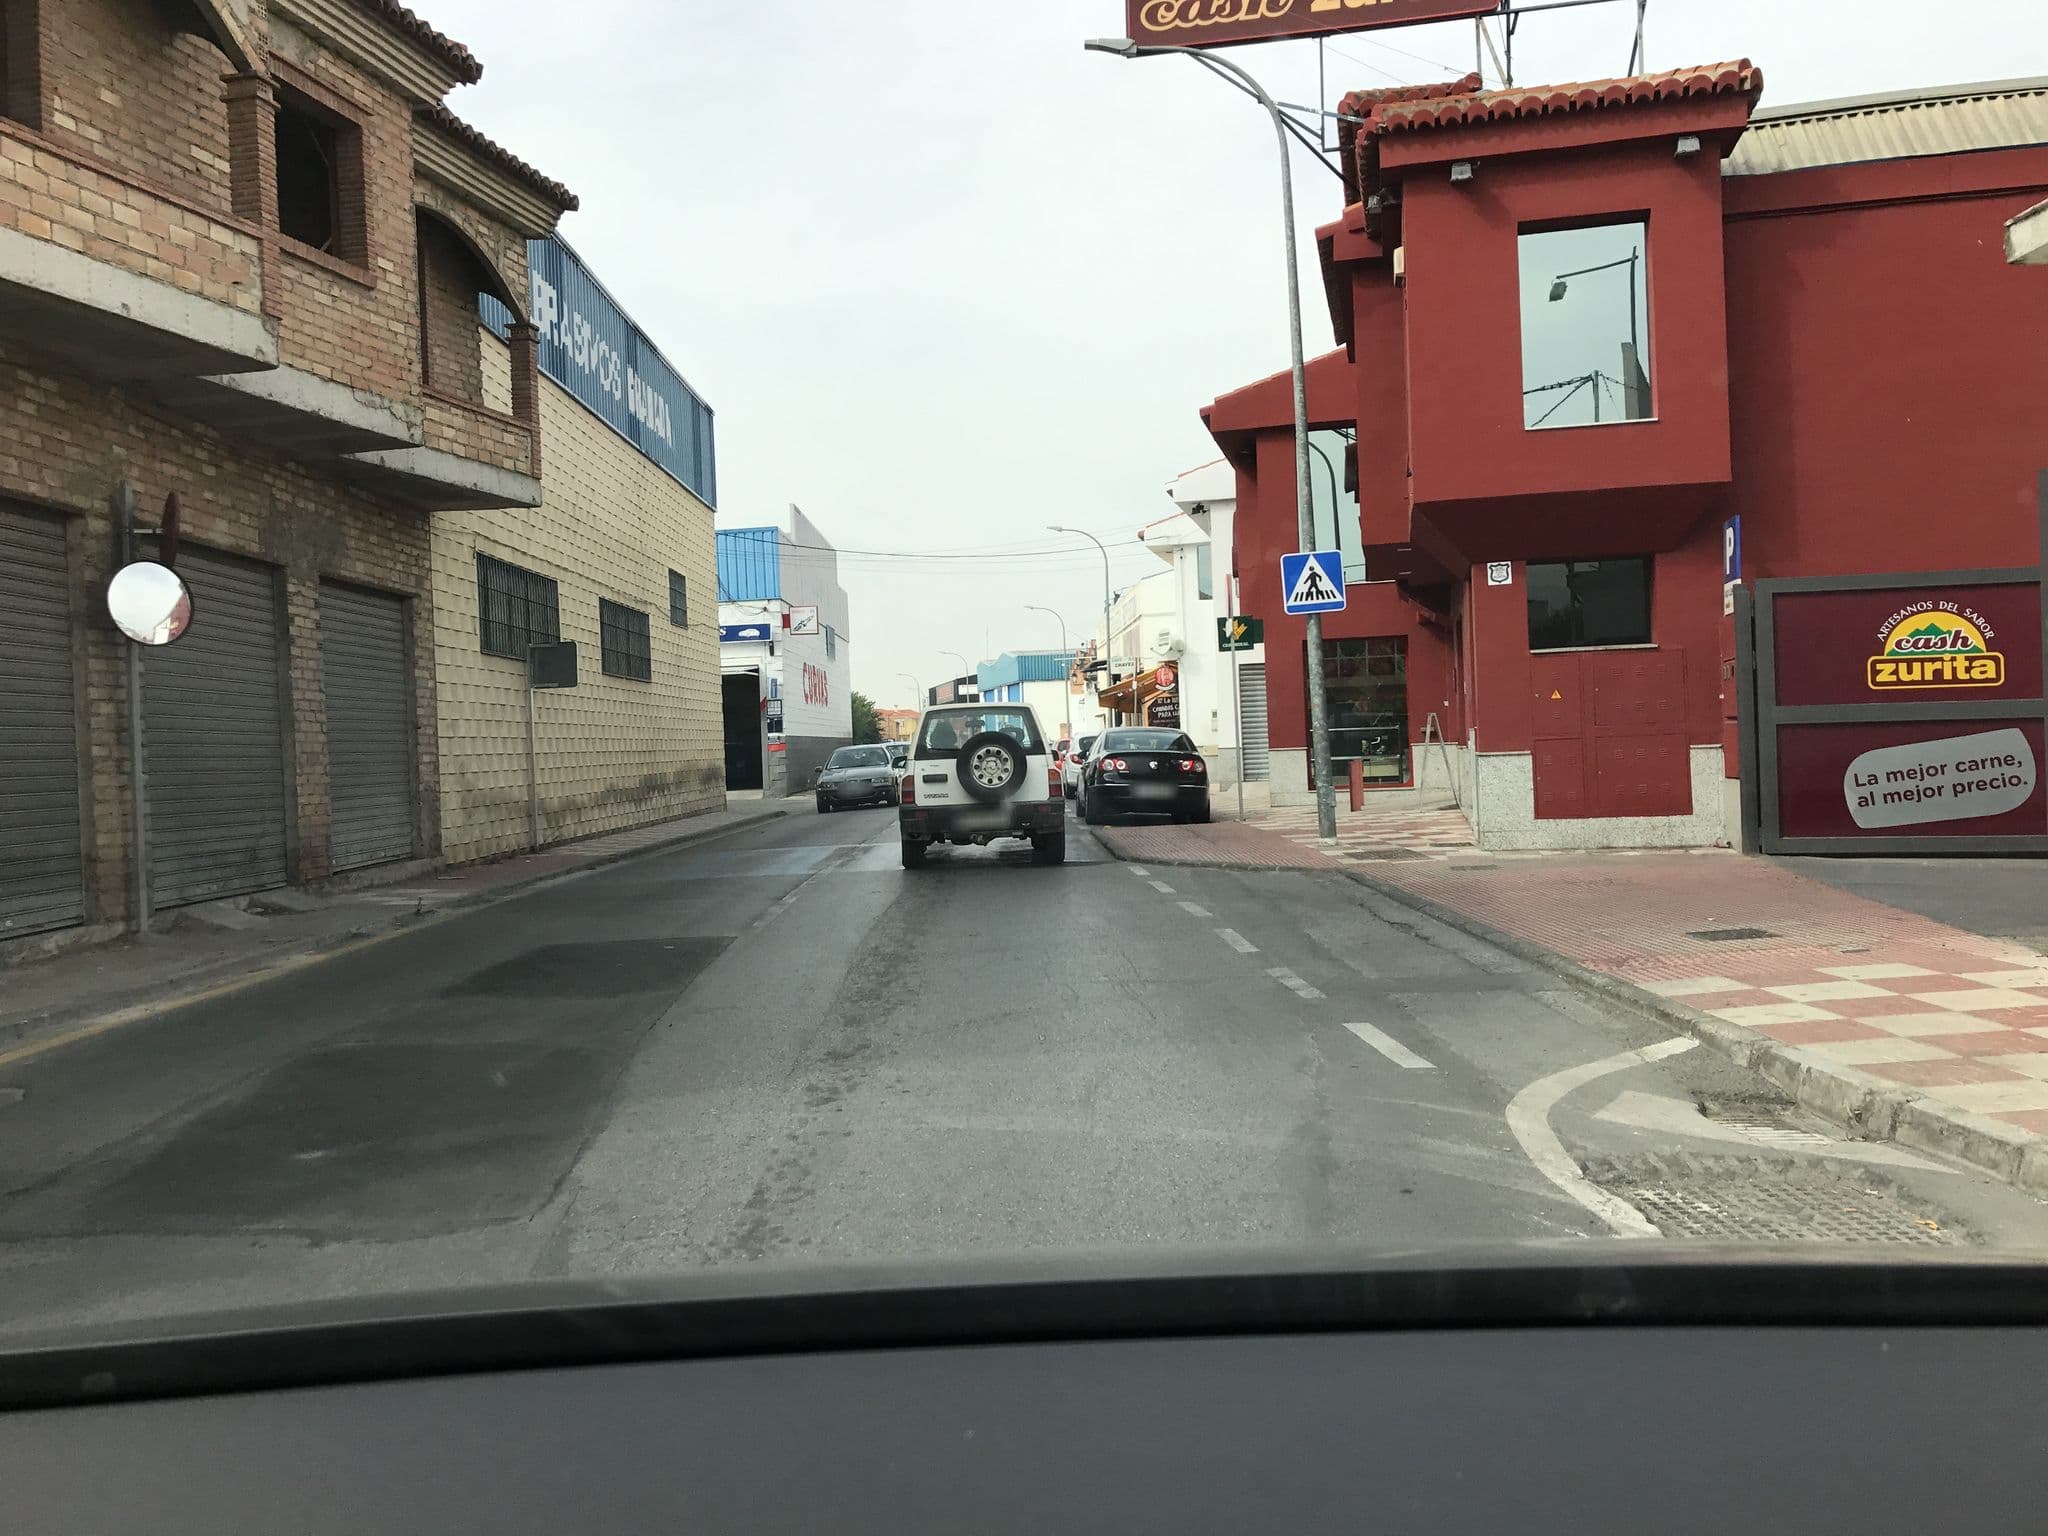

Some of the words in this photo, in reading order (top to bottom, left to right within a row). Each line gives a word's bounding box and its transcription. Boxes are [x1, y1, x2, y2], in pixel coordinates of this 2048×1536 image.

[527, 270, 621, 401] BRASIVOS
[1726, 526, 1734, 575] P
[1877, 601, 1933, 642] ARTESANOS
[1939, 600, 1959, 613] DEL
[1963, 608, 1995, 639] SABOR
[1893, 628, 1975, 652] cash
[1875, 654, 1997, 682] zurita
[1853, 773, 1879, 787] La
[1885, 763, 1947, 783] mejor
[1954, 754, 2023, 773] carne,
[1857, 791, 1875, 808] al
[1882, 785, 1945, 804] mejor
[1952, 773, 2028, 797] precio.
